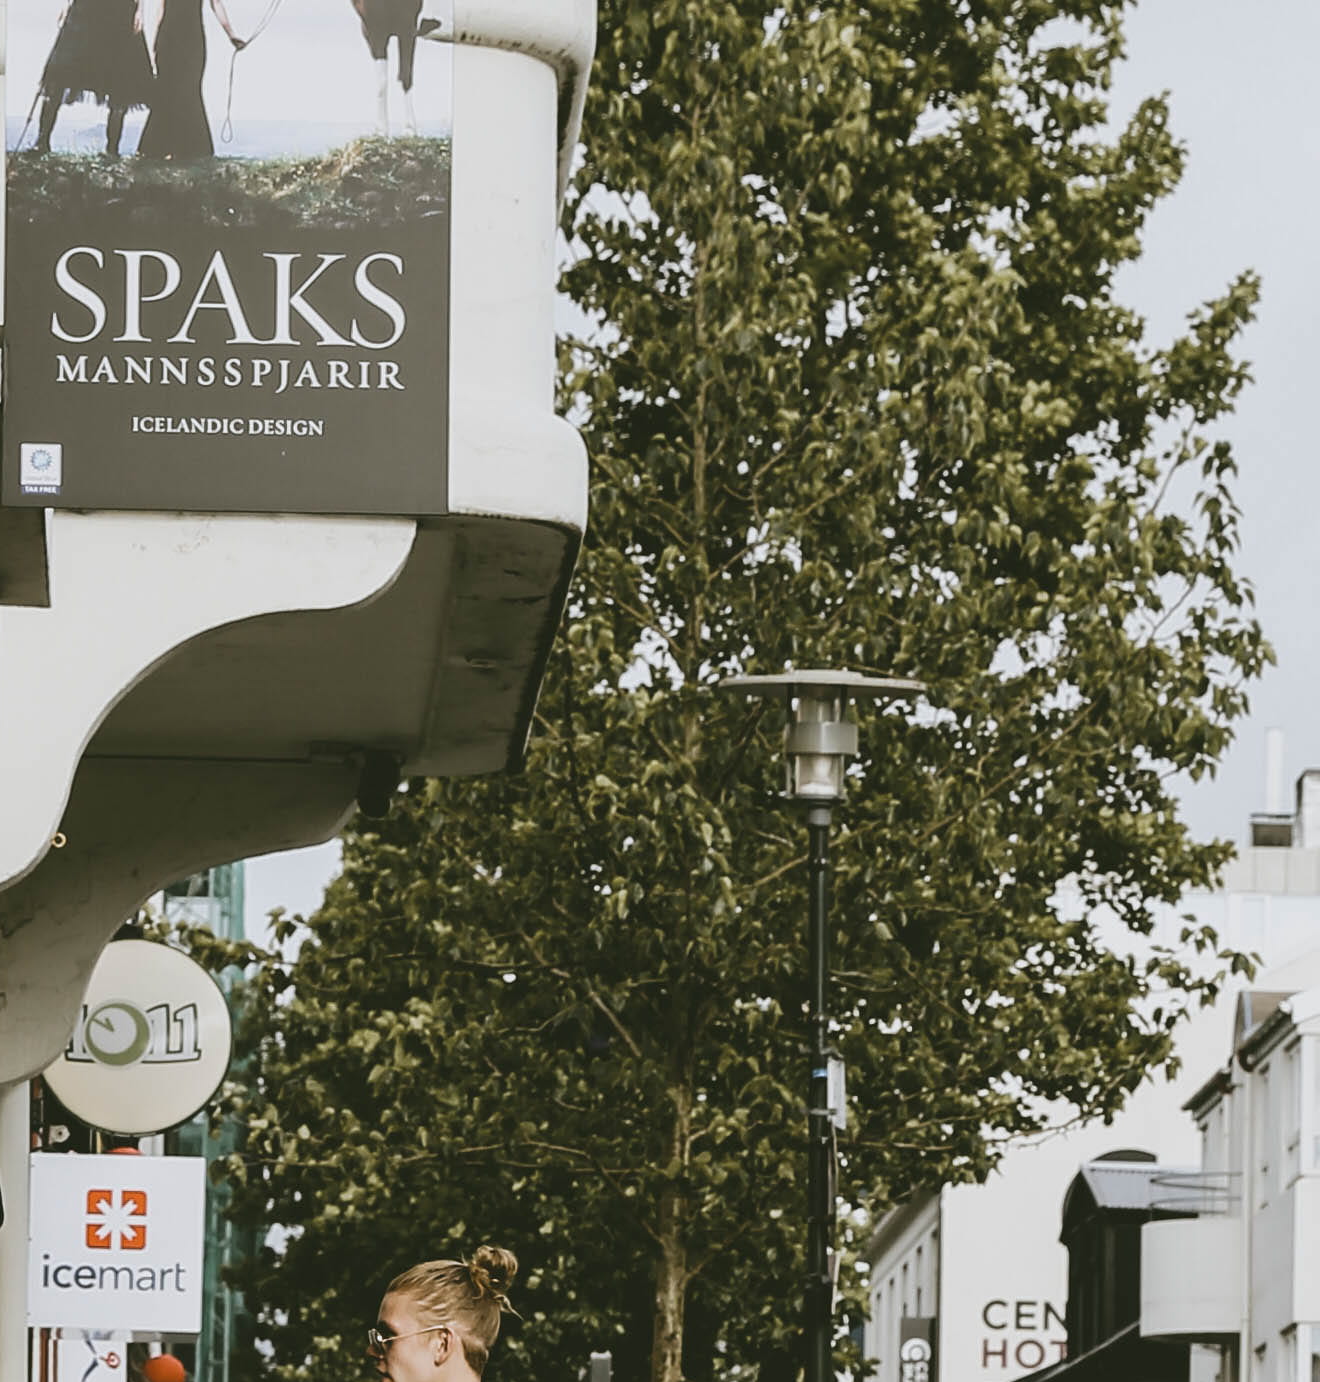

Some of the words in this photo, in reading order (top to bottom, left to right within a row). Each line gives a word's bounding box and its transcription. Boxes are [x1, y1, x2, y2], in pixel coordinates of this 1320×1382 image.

[50, 246, 407, 349] SPAKS
[56, 354, 405, 394] MANNSSPJARIR
[132, 415, 244, 435] ICELANDIC
[248, 419, 324, 436] DESIGN
[42, 1253, 186, 1292] icemart
